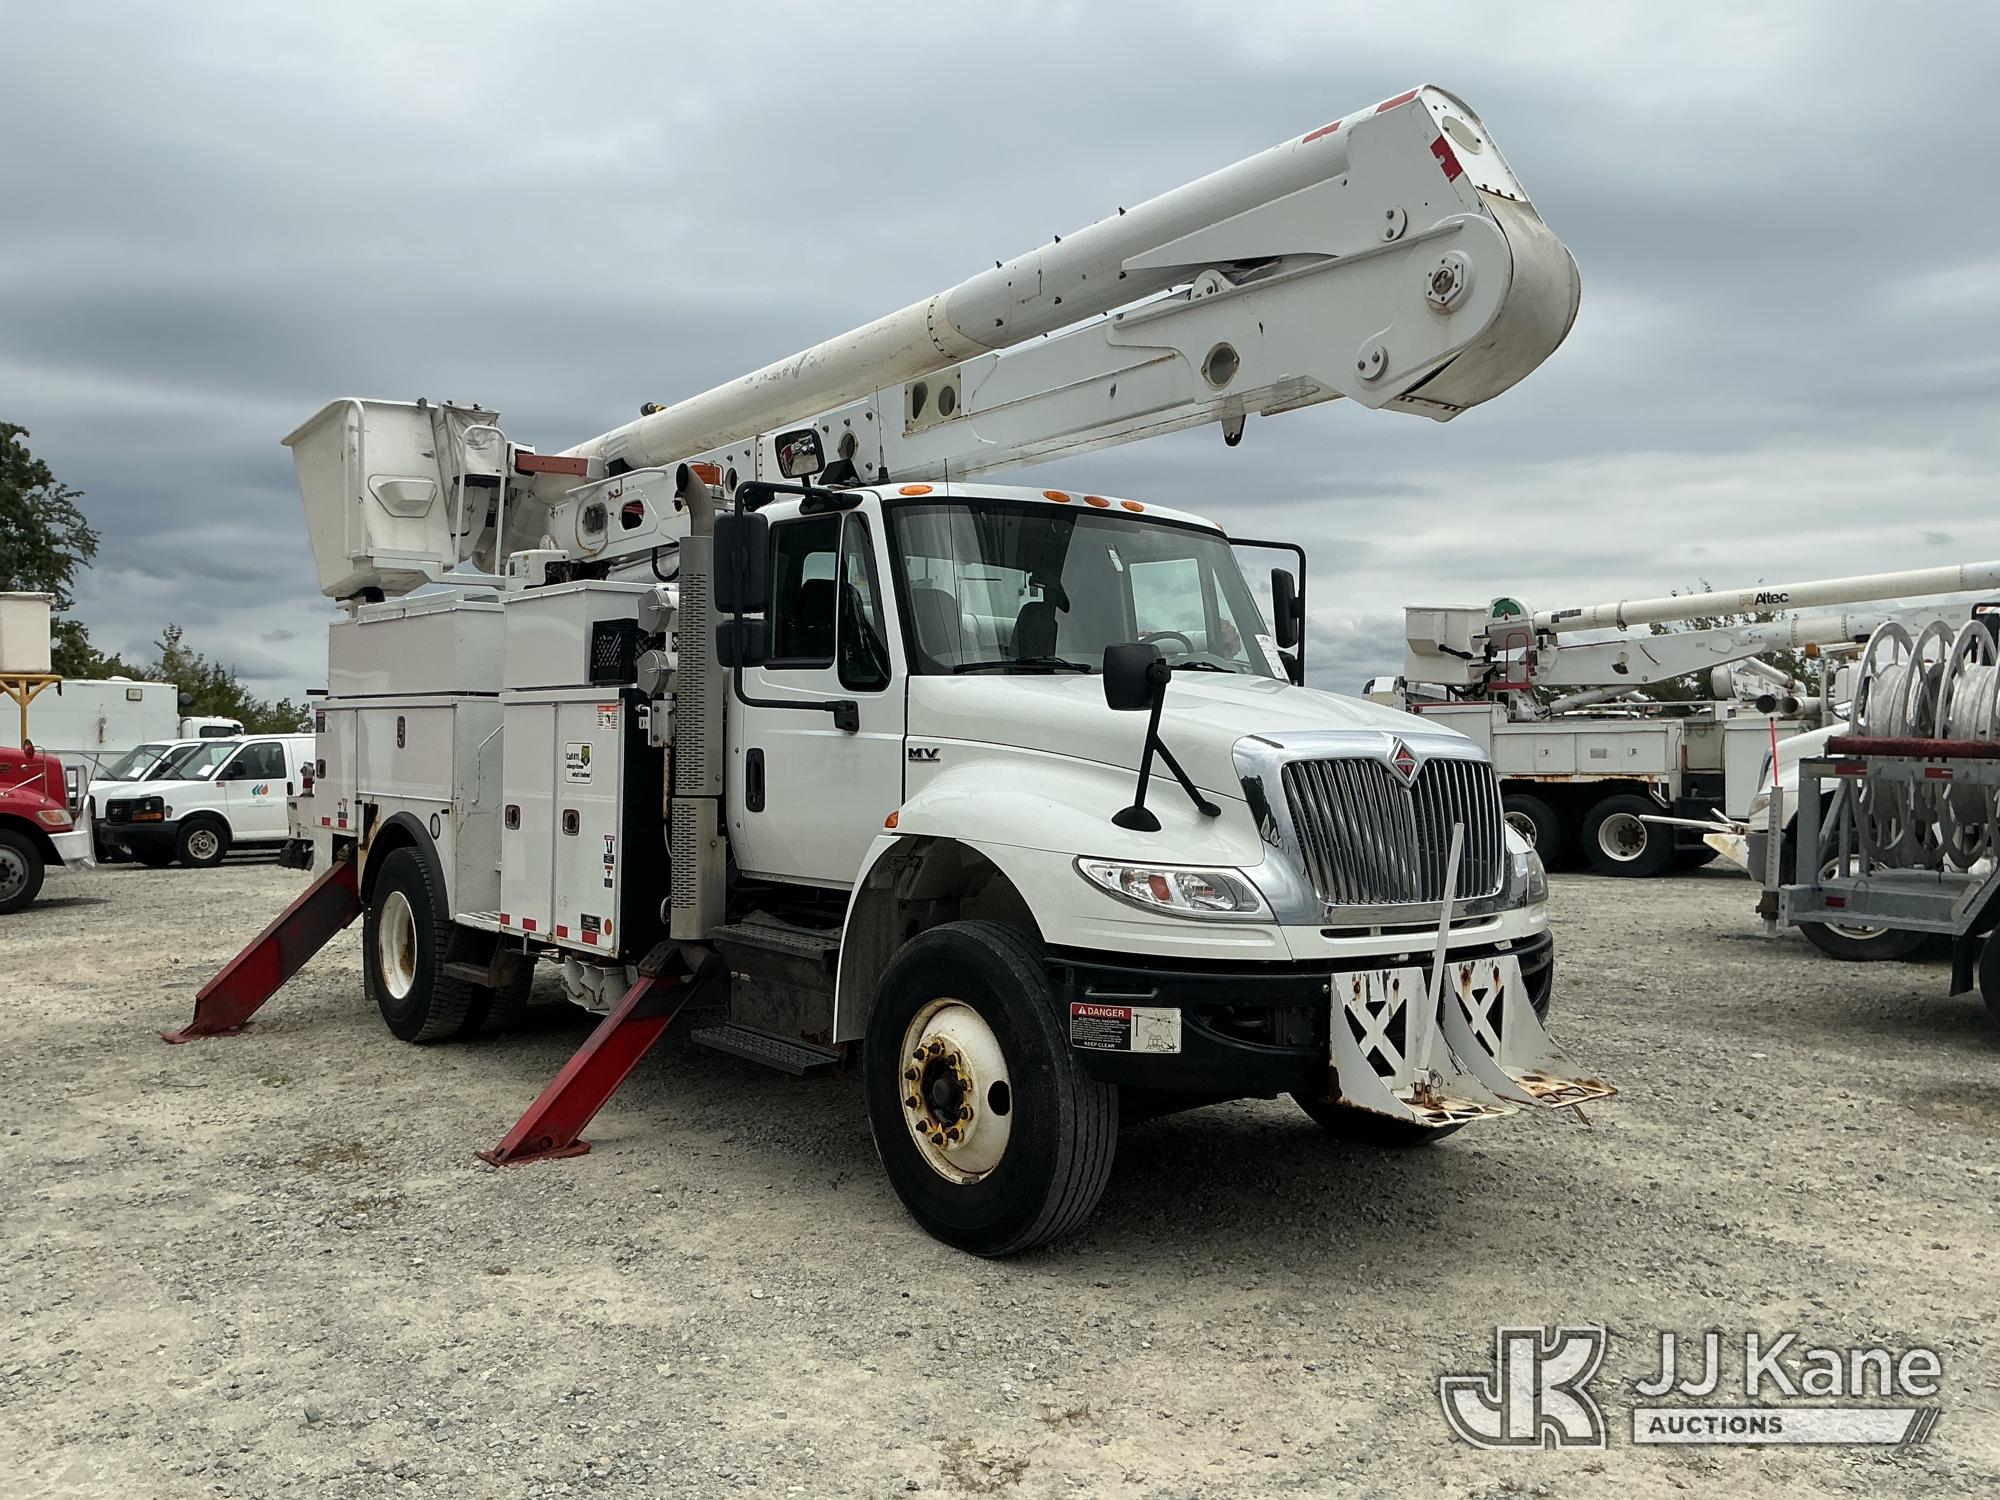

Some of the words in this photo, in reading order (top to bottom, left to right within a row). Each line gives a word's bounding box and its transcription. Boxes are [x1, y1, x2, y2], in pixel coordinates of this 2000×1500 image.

[1755, 592, 1789, 605] Altec
[908, 748, 941, 759] MV
[1087, 1007, 1125, 1017] DANGER
